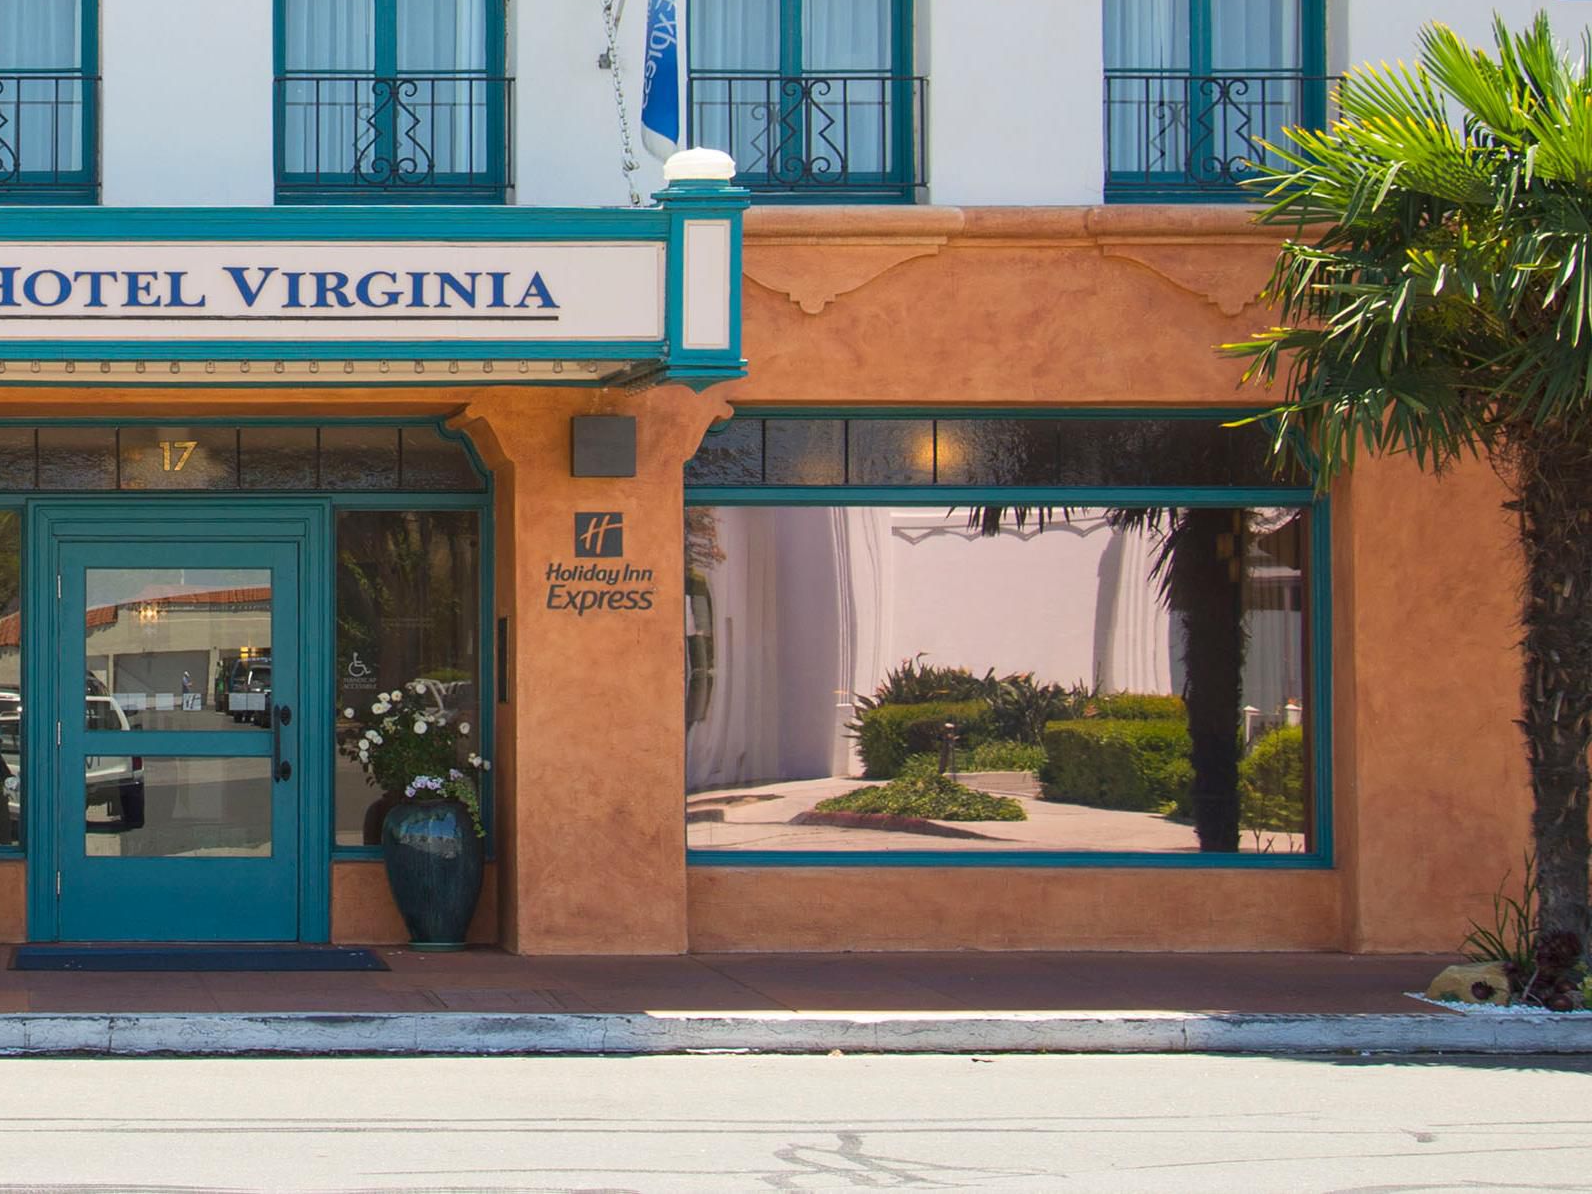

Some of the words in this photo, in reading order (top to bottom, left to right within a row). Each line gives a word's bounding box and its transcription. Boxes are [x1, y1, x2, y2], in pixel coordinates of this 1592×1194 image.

[222, 266, 561, 309] VIRGINIA
[159, 441, 198, 471] 17
[545, 563, 620, 585] Holiday
[623, 563, 653, 582] Inn
[546, 584, 653, 616] Express
